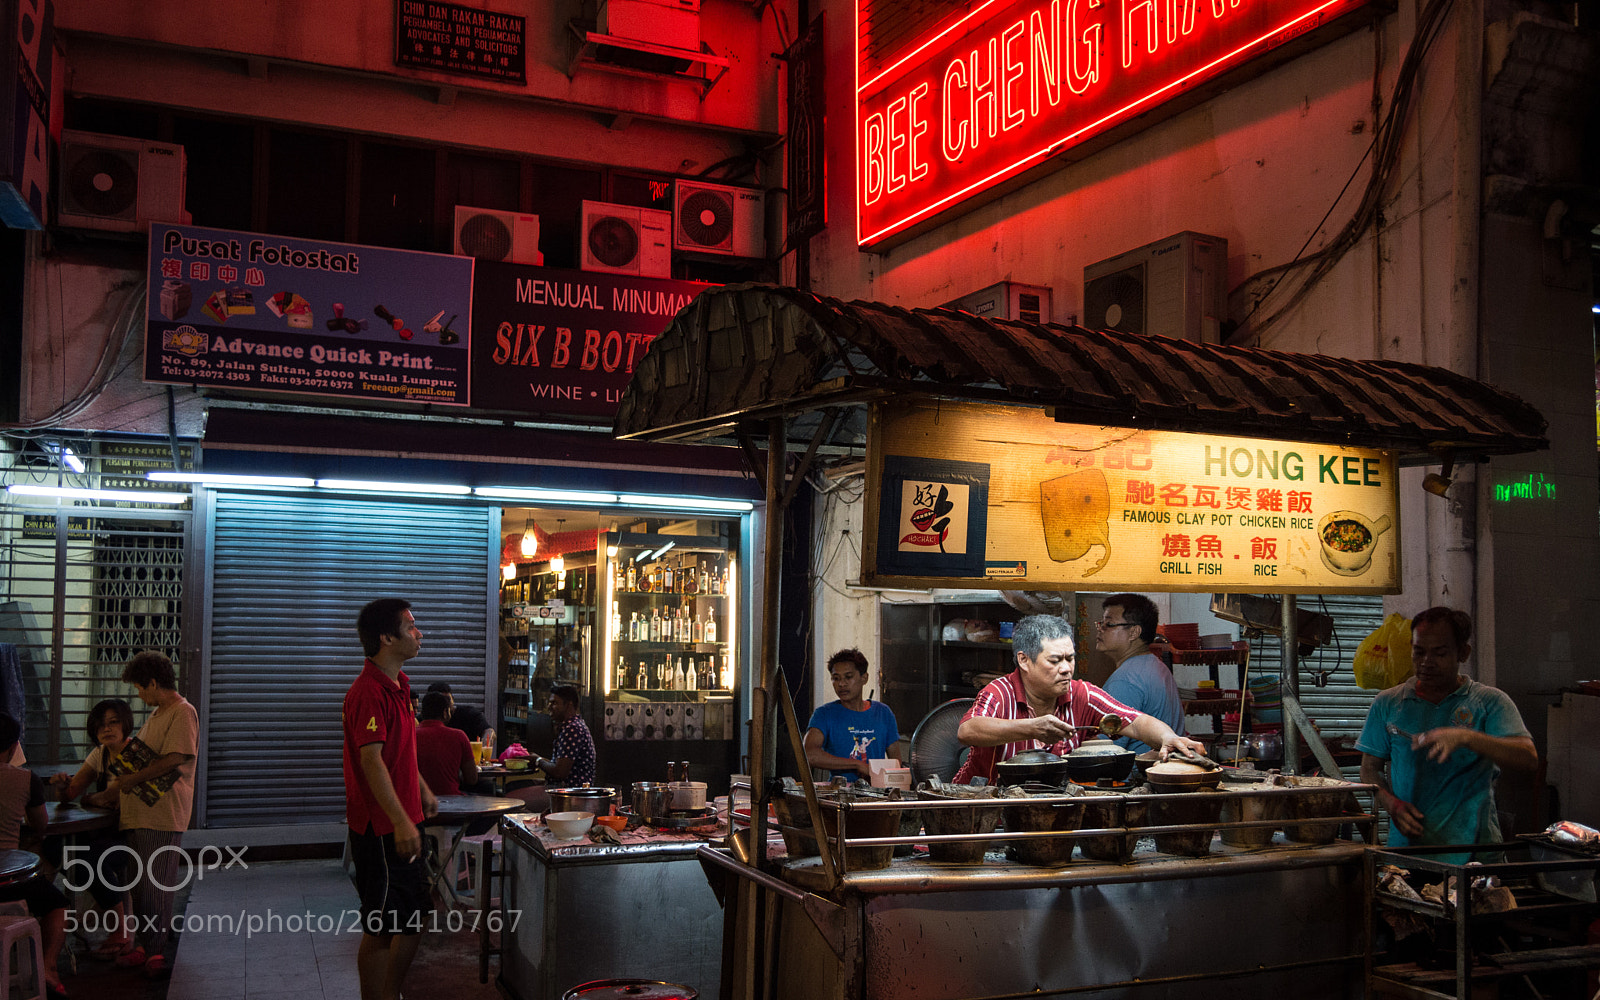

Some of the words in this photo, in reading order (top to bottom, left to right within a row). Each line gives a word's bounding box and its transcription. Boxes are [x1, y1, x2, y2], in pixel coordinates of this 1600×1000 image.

[403, 1, 424, 17] CHIN
[429, 4, 448, 20] DAN
[452, 8, 522, 32] RAKAN-RAKAN
[403, 15, 452, 32] PEGUAMBELA
[456, 23, 471, 36] DAN
[474, 27, 521, 44] PEGUAMCARA
[407, 28, 451, 44] ADVOCATES
[454, 35, 470, 48] AND
[474, 39, 518, 56] SOLICITORS
[865, 82, 929, 206] BEE
[943, 0, 1101, 162] CHENG
[163, 229, 242, 261] Pusat
[248, 239, 359, 275] Fotostat
[516, 278, 604, 311] MENJUAL
[211, 336, 304, 360] Advance
[310, 344, 373, 365] Quick
[378, 350, 433, 371] Print
[492, 321, 546, 368] SIX
[551, 326, 572, 369] B
[161, 355, 185, 366] No.
[190, 358, 212, 370] 89,
[216, 360, 255, 372] Jalan
[260, 363, 311, 378] Sultan,
[315, 368, 355, 379] 50000
[359, 371, 398, 383] Kuala
[402, 374, 457, 388] Lumpur.
[161, 365, 181, 376] Tel:
[184, 368, 224, 379] 03-2072
[226, 371, 251, 382] 4303
[260, 373, 287, 384] Faks:
[289, 376, 328, 387] 03-2072
[330, 380, 354, 390] 6372
[530, 383, 582, 401] WINE
[606, 388, 625, 403] LI
[1204, 445, 1304, 481] HONG
[1318, 454, 1381, 487] KEE
[25, 521, 39, 529] CHIN
[1123, 509, 1171, 524] FAMOUS
[1176, 512, 1205, 525] CLAY
[1211, 514, 1233, 526] POT
[1239, 515, 1286, 529] CHICKEN
[1290, 517, 1314, 530] RICE
[1160, 561, 1192, 575] GRILL
[1197, 562, 1222, 575] FISH
[1254, 564, 1278, 576] RICE
[366, 716, 378, 732] 4
